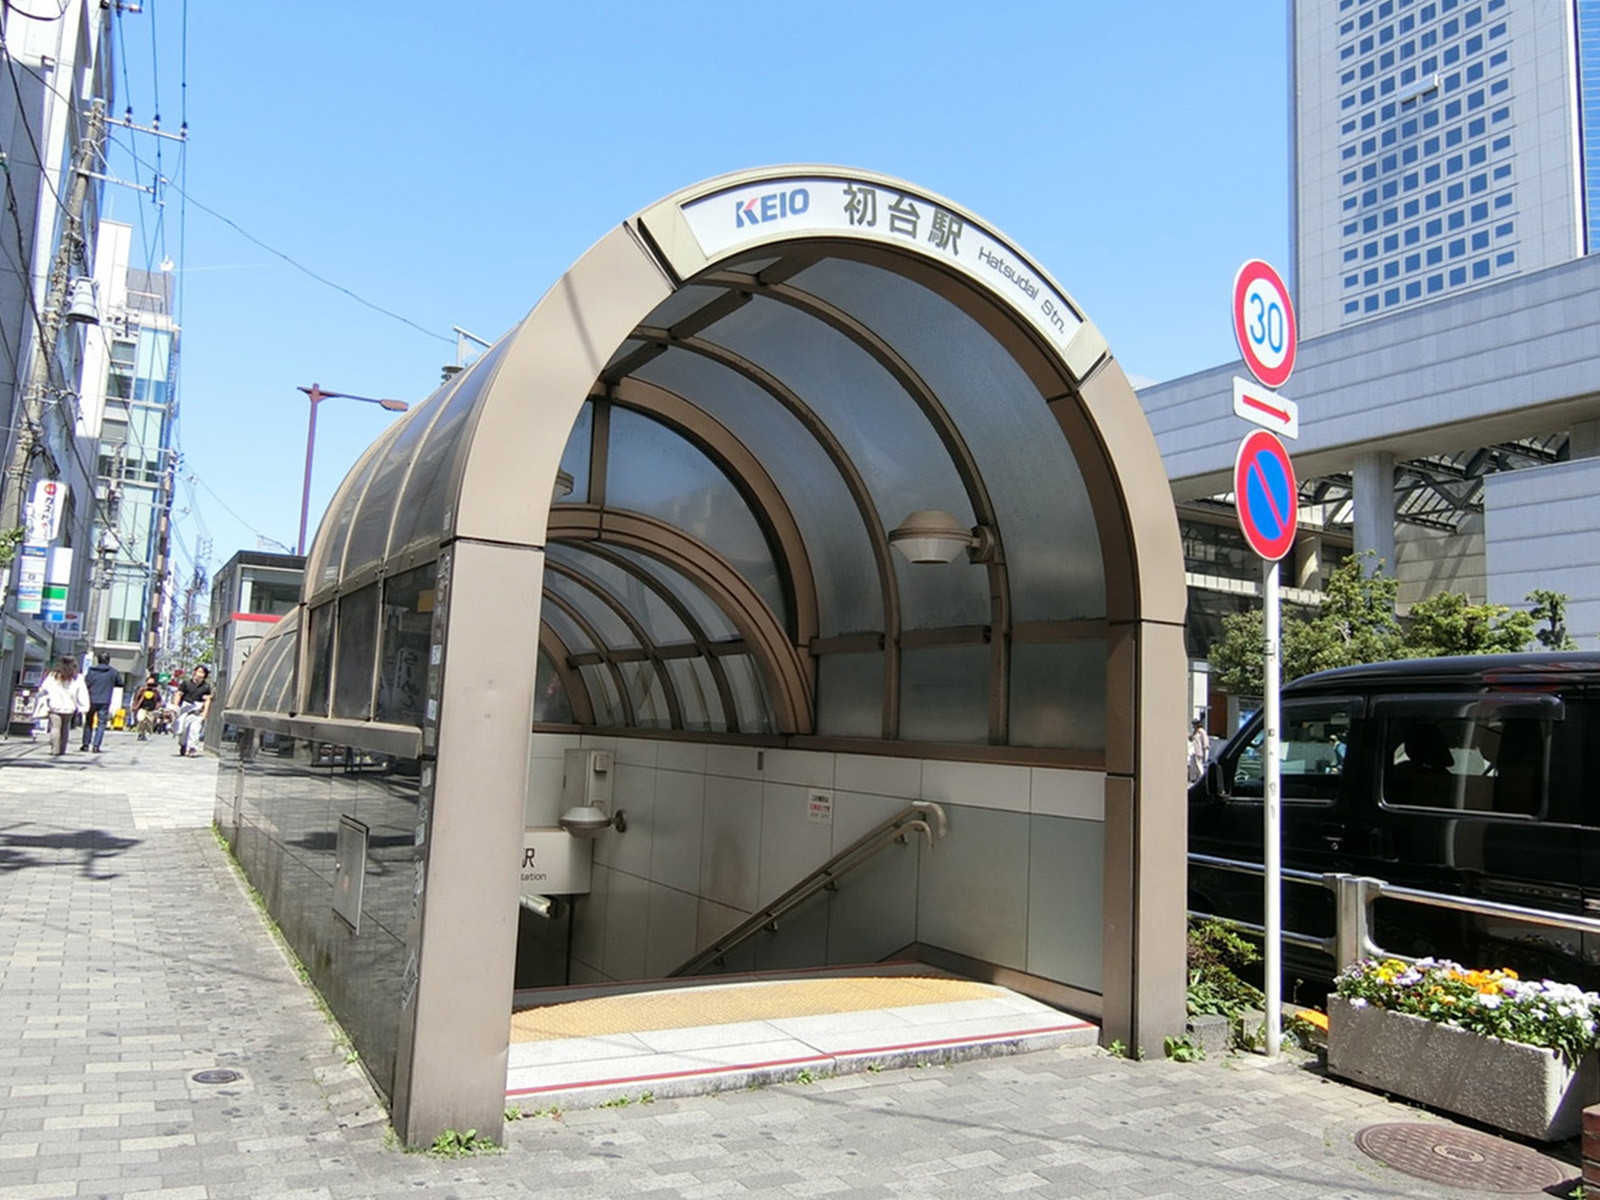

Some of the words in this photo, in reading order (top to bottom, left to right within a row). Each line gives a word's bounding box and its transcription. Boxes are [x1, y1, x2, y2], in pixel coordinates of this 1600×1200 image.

[736, 188, 810, 229] KEIO
[843, 182, 965, 257] 初台駅
[978, 245, 1040, 301] Hatsudai
[1041, 299, 1065, 334] Stn.
[1249, 292, 1283, 354] 30
[520, 873, 547, 881] tation
